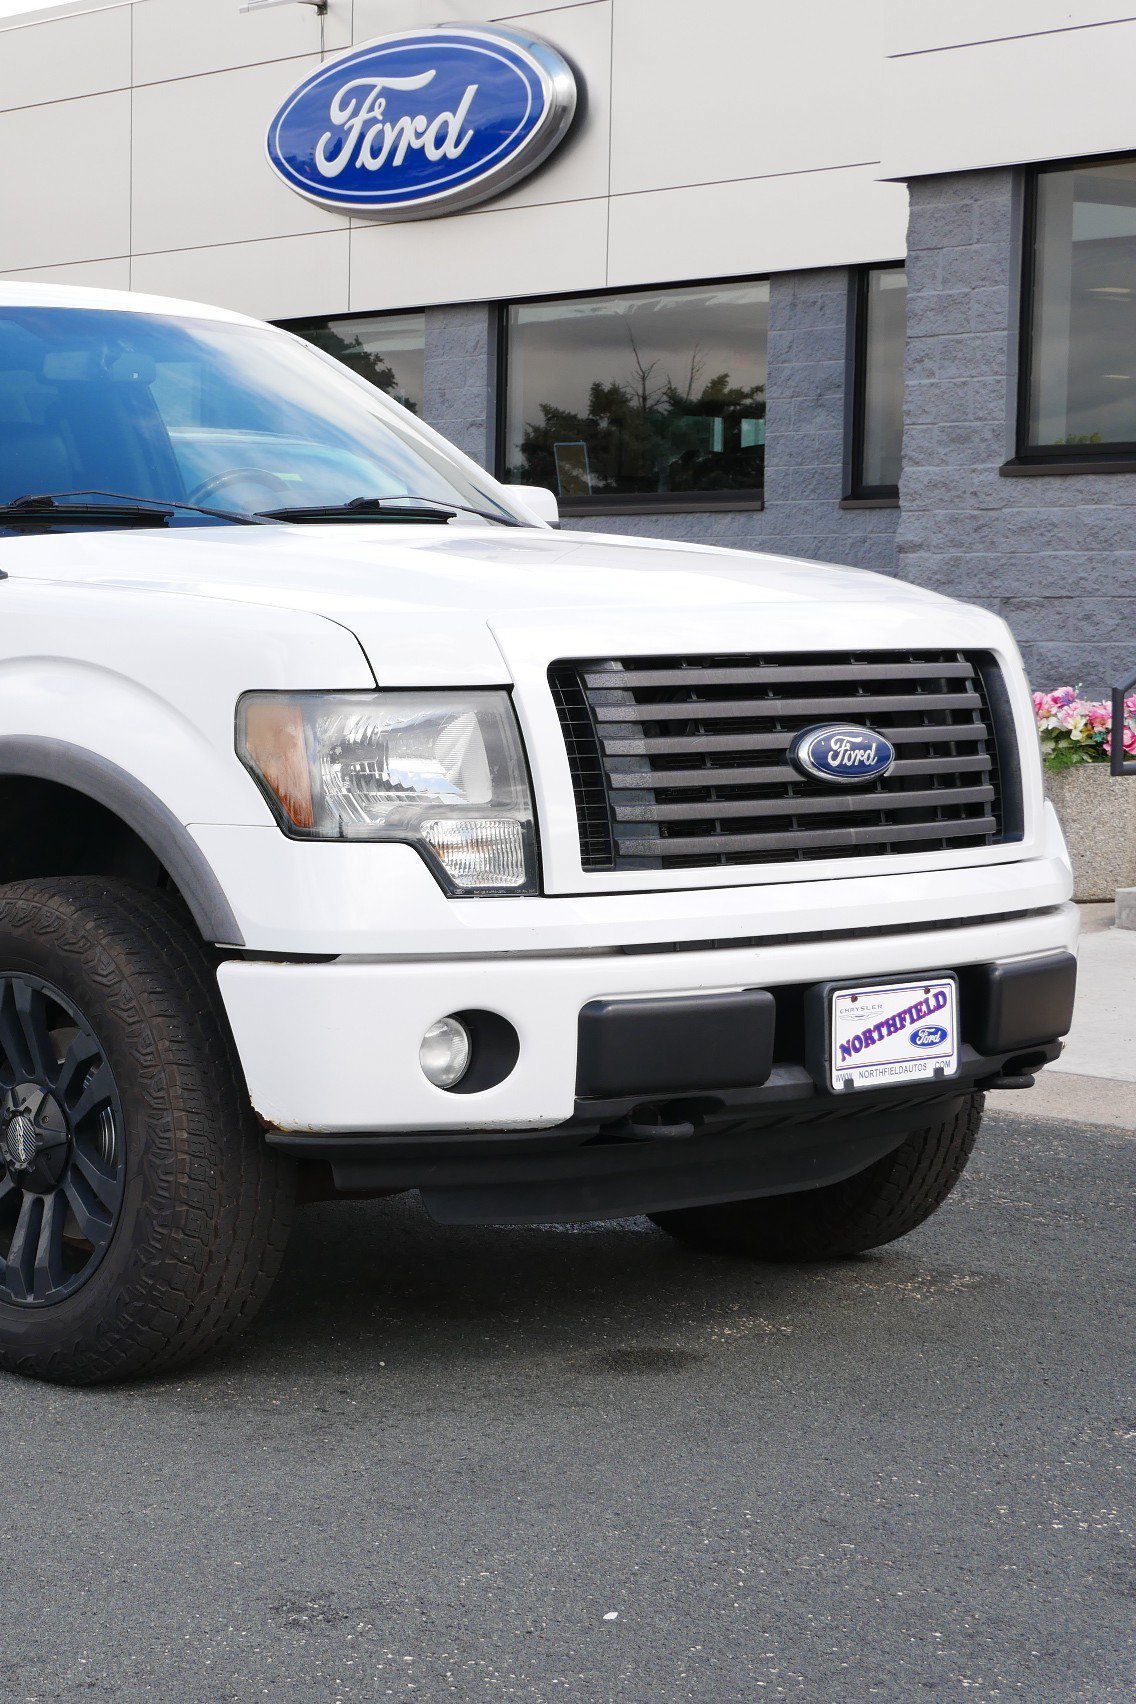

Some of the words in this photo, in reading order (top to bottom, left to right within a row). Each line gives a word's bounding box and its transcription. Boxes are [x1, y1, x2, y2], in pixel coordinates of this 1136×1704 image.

[315, 68, 479, 179] Ford
[827, 735, 878, 767] Ford
[839, 1004, 883, 1014] CHRYSLER
[838, 990, 948, 1063] NORTHFIELD
[915, 1026, 942, 1045] Ford
[858, 1063, 927, 1079] NORTHFIELDAUTOS
